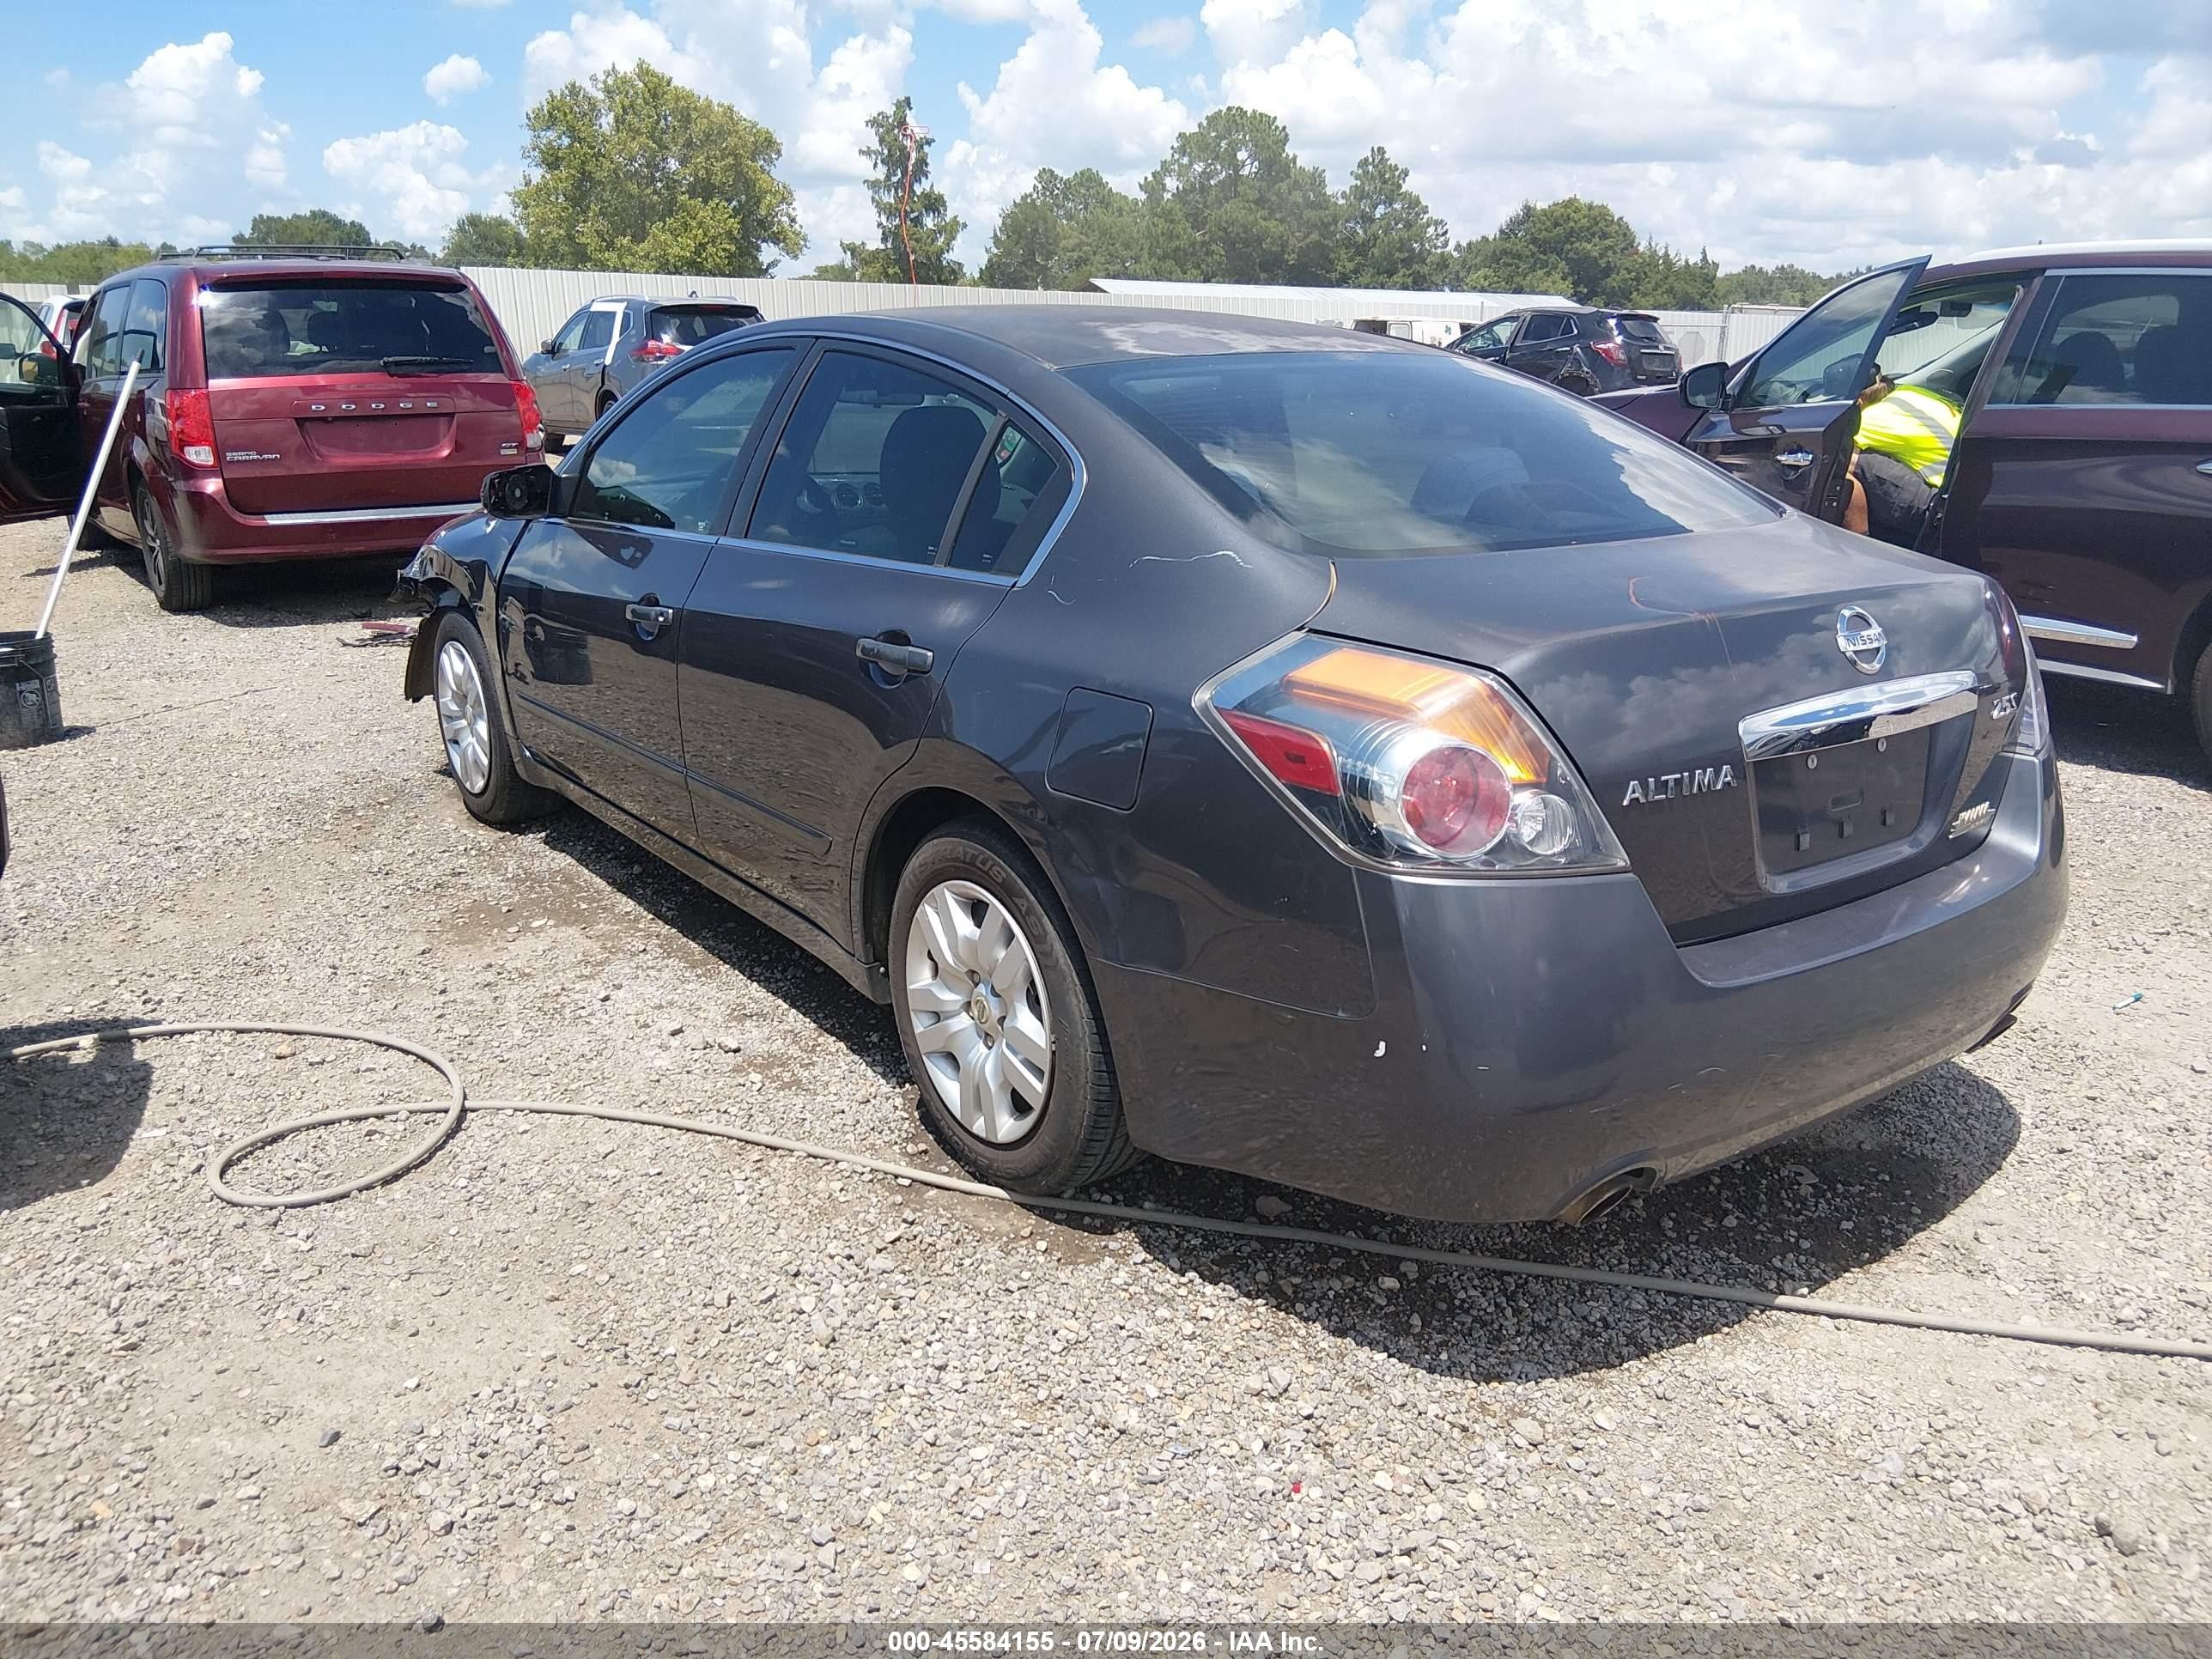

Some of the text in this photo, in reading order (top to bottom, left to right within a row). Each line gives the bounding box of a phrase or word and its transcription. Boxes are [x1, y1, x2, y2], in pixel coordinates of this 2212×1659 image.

[311, 401, 438, 410] DODGE
[1845, 632, 1885, 647] NISSAN
[1621, 765, 1738, 806] ALTIMA
